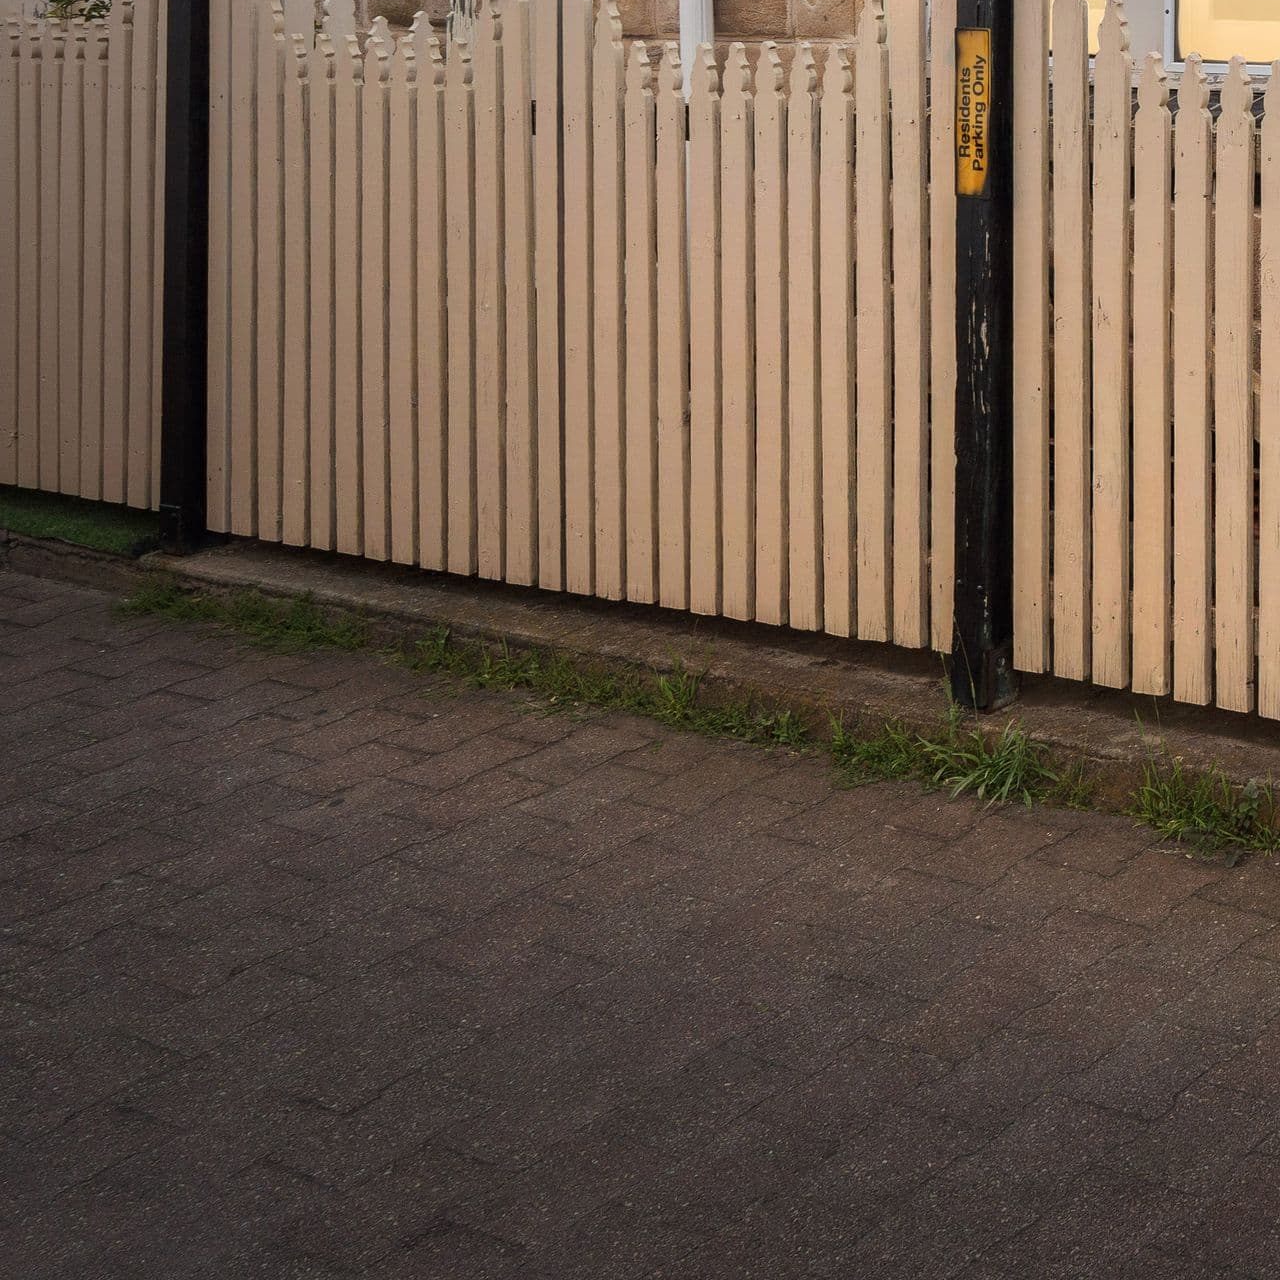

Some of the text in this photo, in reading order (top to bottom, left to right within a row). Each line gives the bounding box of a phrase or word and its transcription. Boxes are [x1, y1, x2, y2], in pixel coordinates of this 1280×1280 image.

[958, 66, 971, 158] Residents
[972, 54, 987, 171] Parking Only
